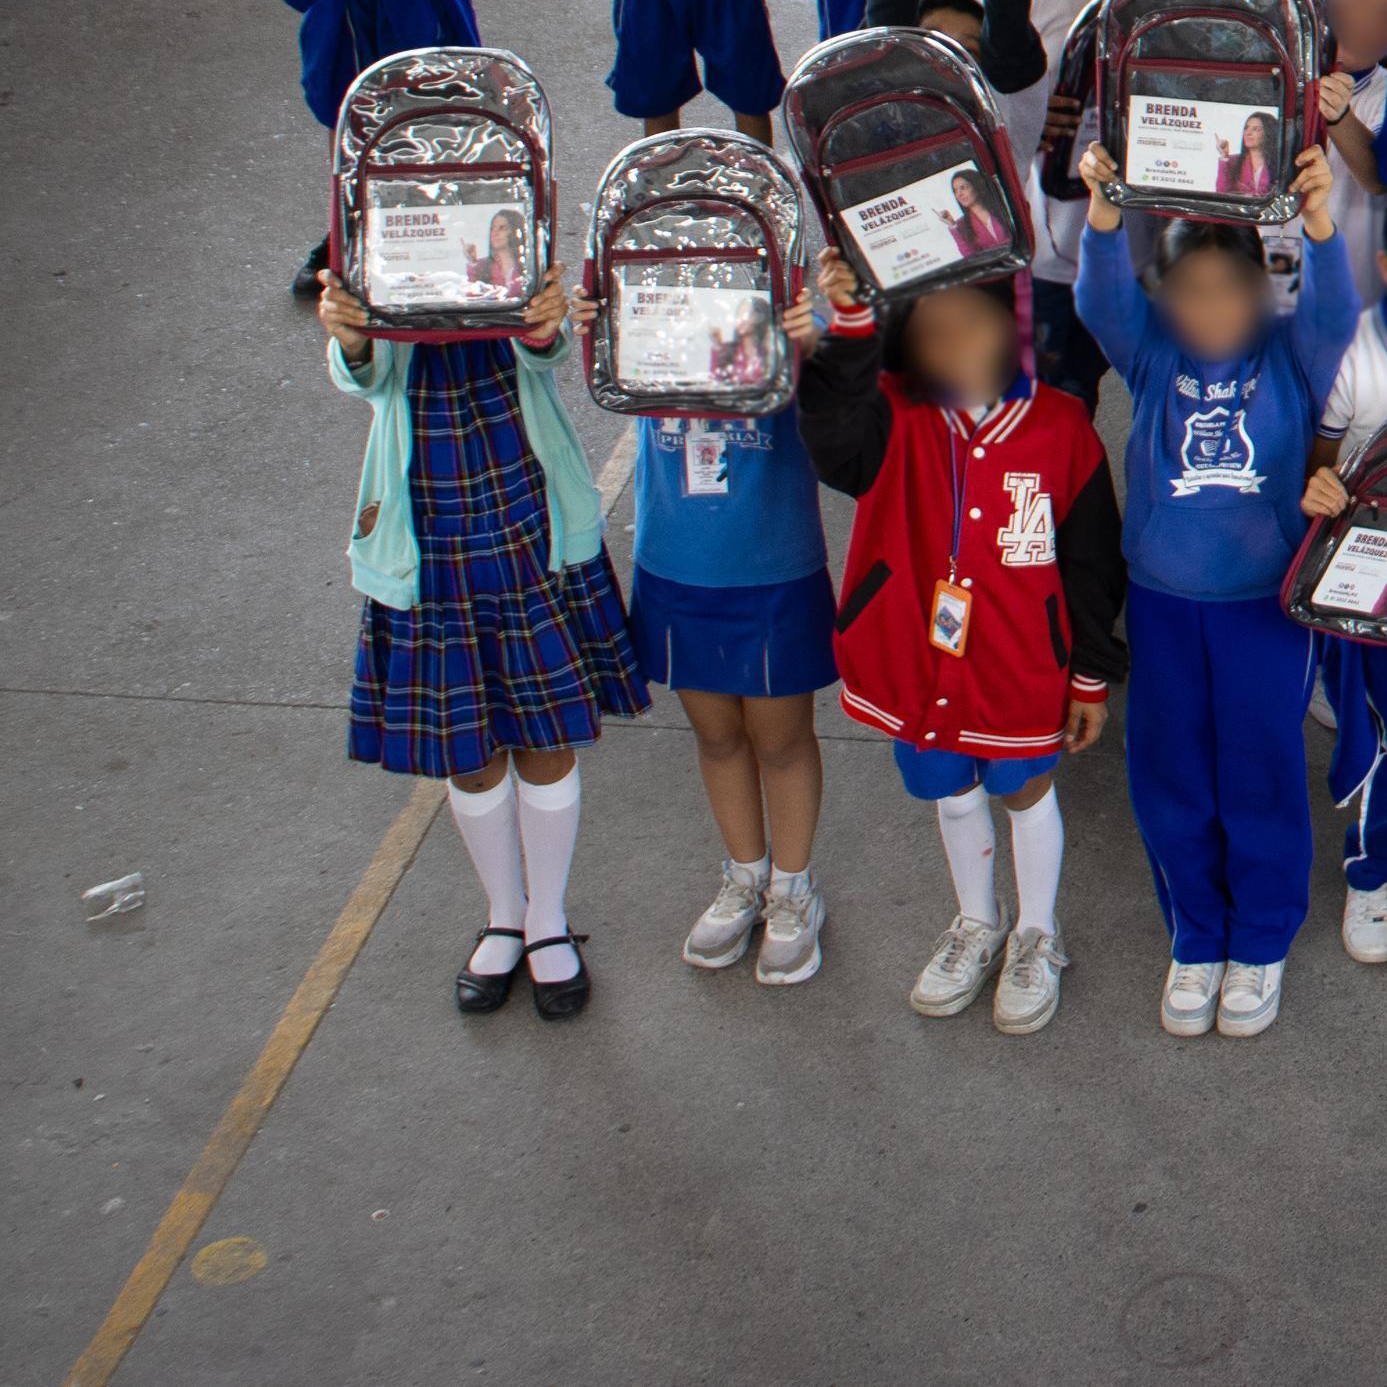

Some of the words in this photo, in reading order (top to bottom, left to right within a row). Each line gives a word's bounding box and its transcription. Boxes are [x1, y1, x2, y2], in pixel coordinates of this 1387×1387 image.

[1146, 103, 1196, 118] BRENDA
[1141, 117, 1202, 128] VELÁZQUEZ
[858, 196, 908, 221] BRENDA
[385, 214, 440, 227] BRENDA
[861, 206, 917, 231] VELÁZQUEZ
[382, 226, 445, 239] VELÁZQUEZ
